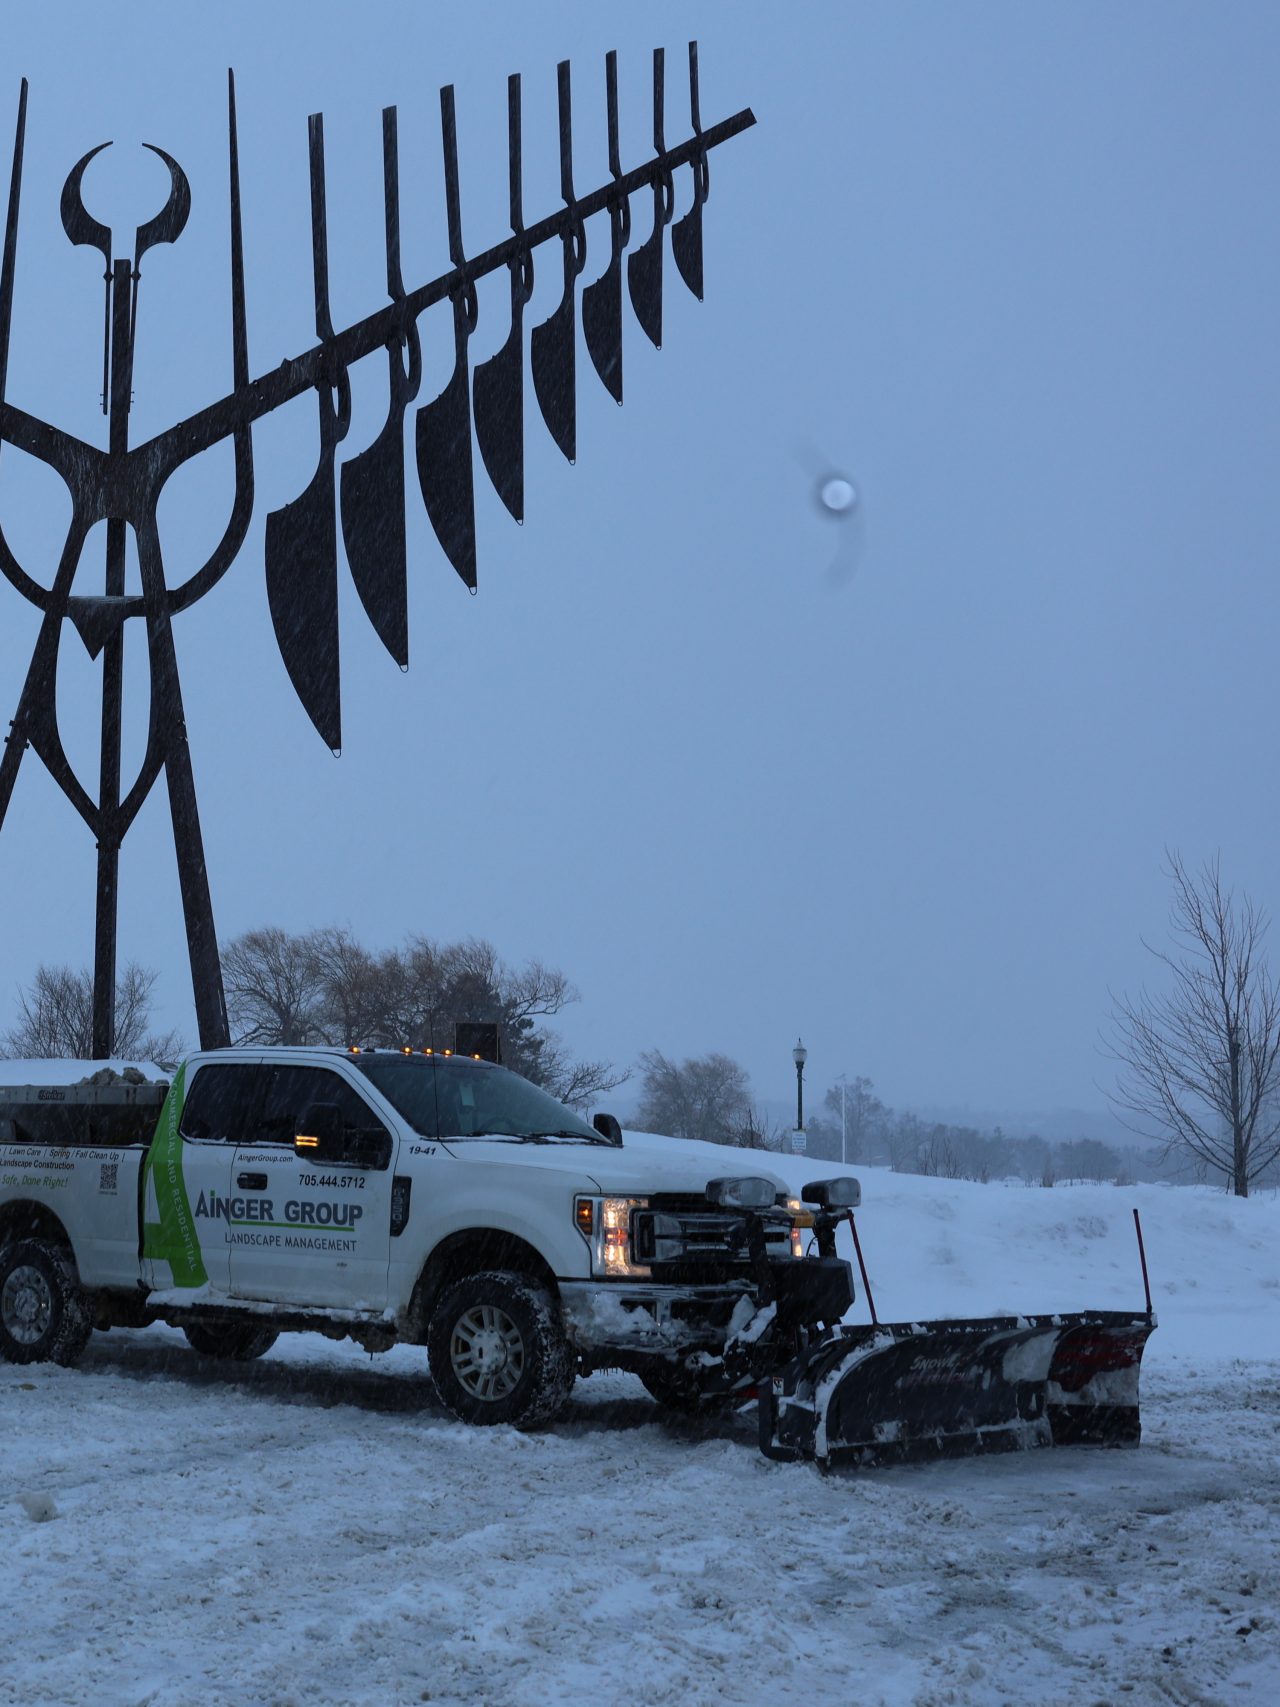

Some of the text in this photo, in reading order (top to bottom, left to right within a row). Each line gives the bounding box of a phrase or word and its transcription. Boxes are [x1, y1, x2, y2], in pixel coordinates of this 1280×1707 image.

[9, 1147, 26, 1155] Lawn
[26, 1147, 41, 1156] Care
[49, 1148, 71, 1160] Spring
[75, 1150, 88, 1158] Fall
[89, 1151, 108, 1159] Clean
[109, 1152, 119, 1161] Up
[409, 1146, 436, 1155] 19-41
[0, 1158, 32, 1169] Landscape
[33, 1159, 74, 1170] Construction
[238, 1153, 293, 1164] AingerGroup.com
[22, 1175, 42, 1186] Done
[43, 1176, 68, 1190] Right!
[168, 1083, 195, 1272] COMMERCIAL AND RESIDENTIAL
[299, 1174, 365, 1189] 705.444.5712
[284, 1200, 363, 1226] GROUP
[225, 1233, 357, 1252] LANDSCAPE MANAGEMENT
